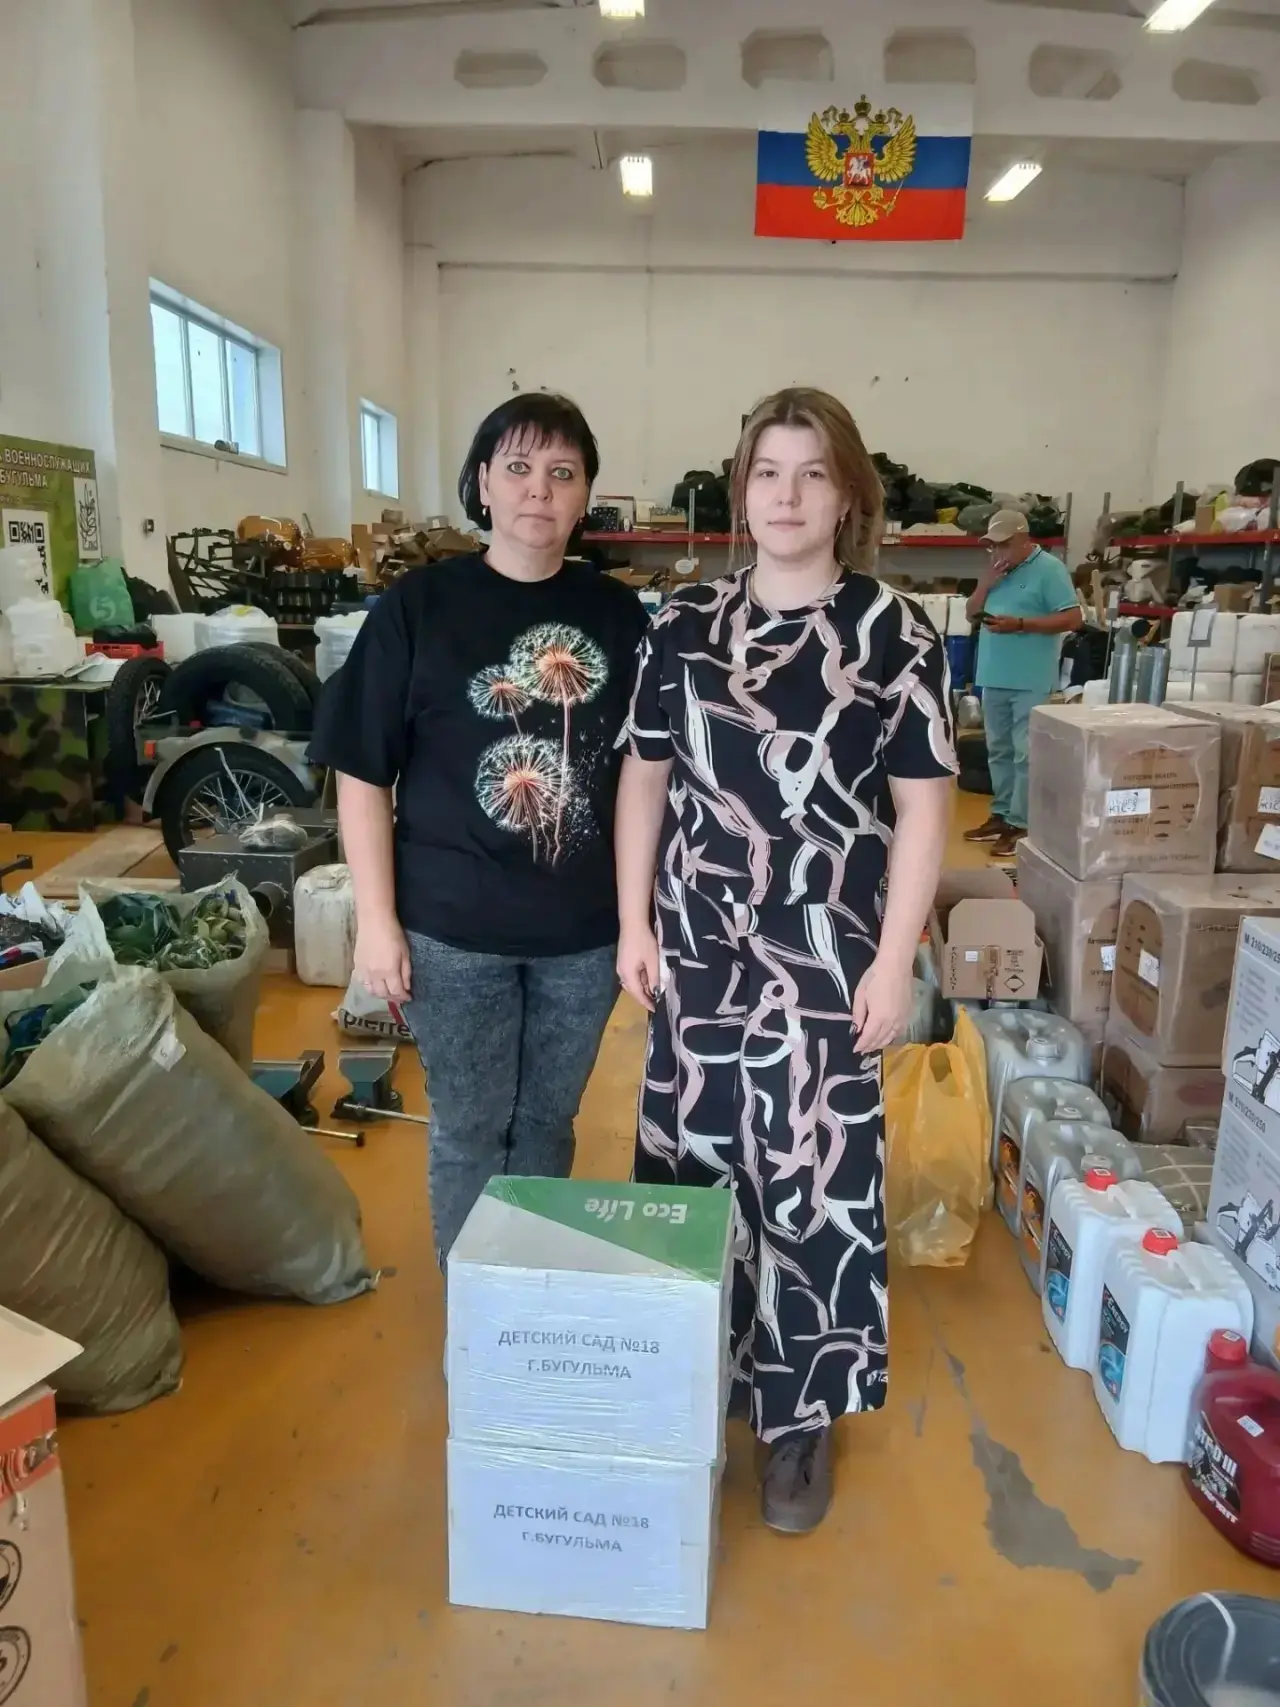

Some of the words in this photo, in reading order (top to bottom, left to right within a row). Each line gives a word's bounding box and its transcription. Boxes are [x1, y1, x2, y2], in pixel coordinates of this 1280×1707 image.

[584, 1197, 635, 1223] Life
[642, 1202, 688, 1225] Eco
[498, 1329, 577, 1346] ДЕТСКИЙ
[581, 1334, 616, 1353] САД
[620, 1337, 660, 1355] №18
[527, 1358, 632, 1379] Г.БУГУЛЬМА
[493, 1503, 568, 1522] ДЕТСКИЙ
[573, 1510, 607, 1527] САД
[611, 1514, 650, 1529] №18
[521, 1530, 623, 1552] Г.БУГУЛЬМА
